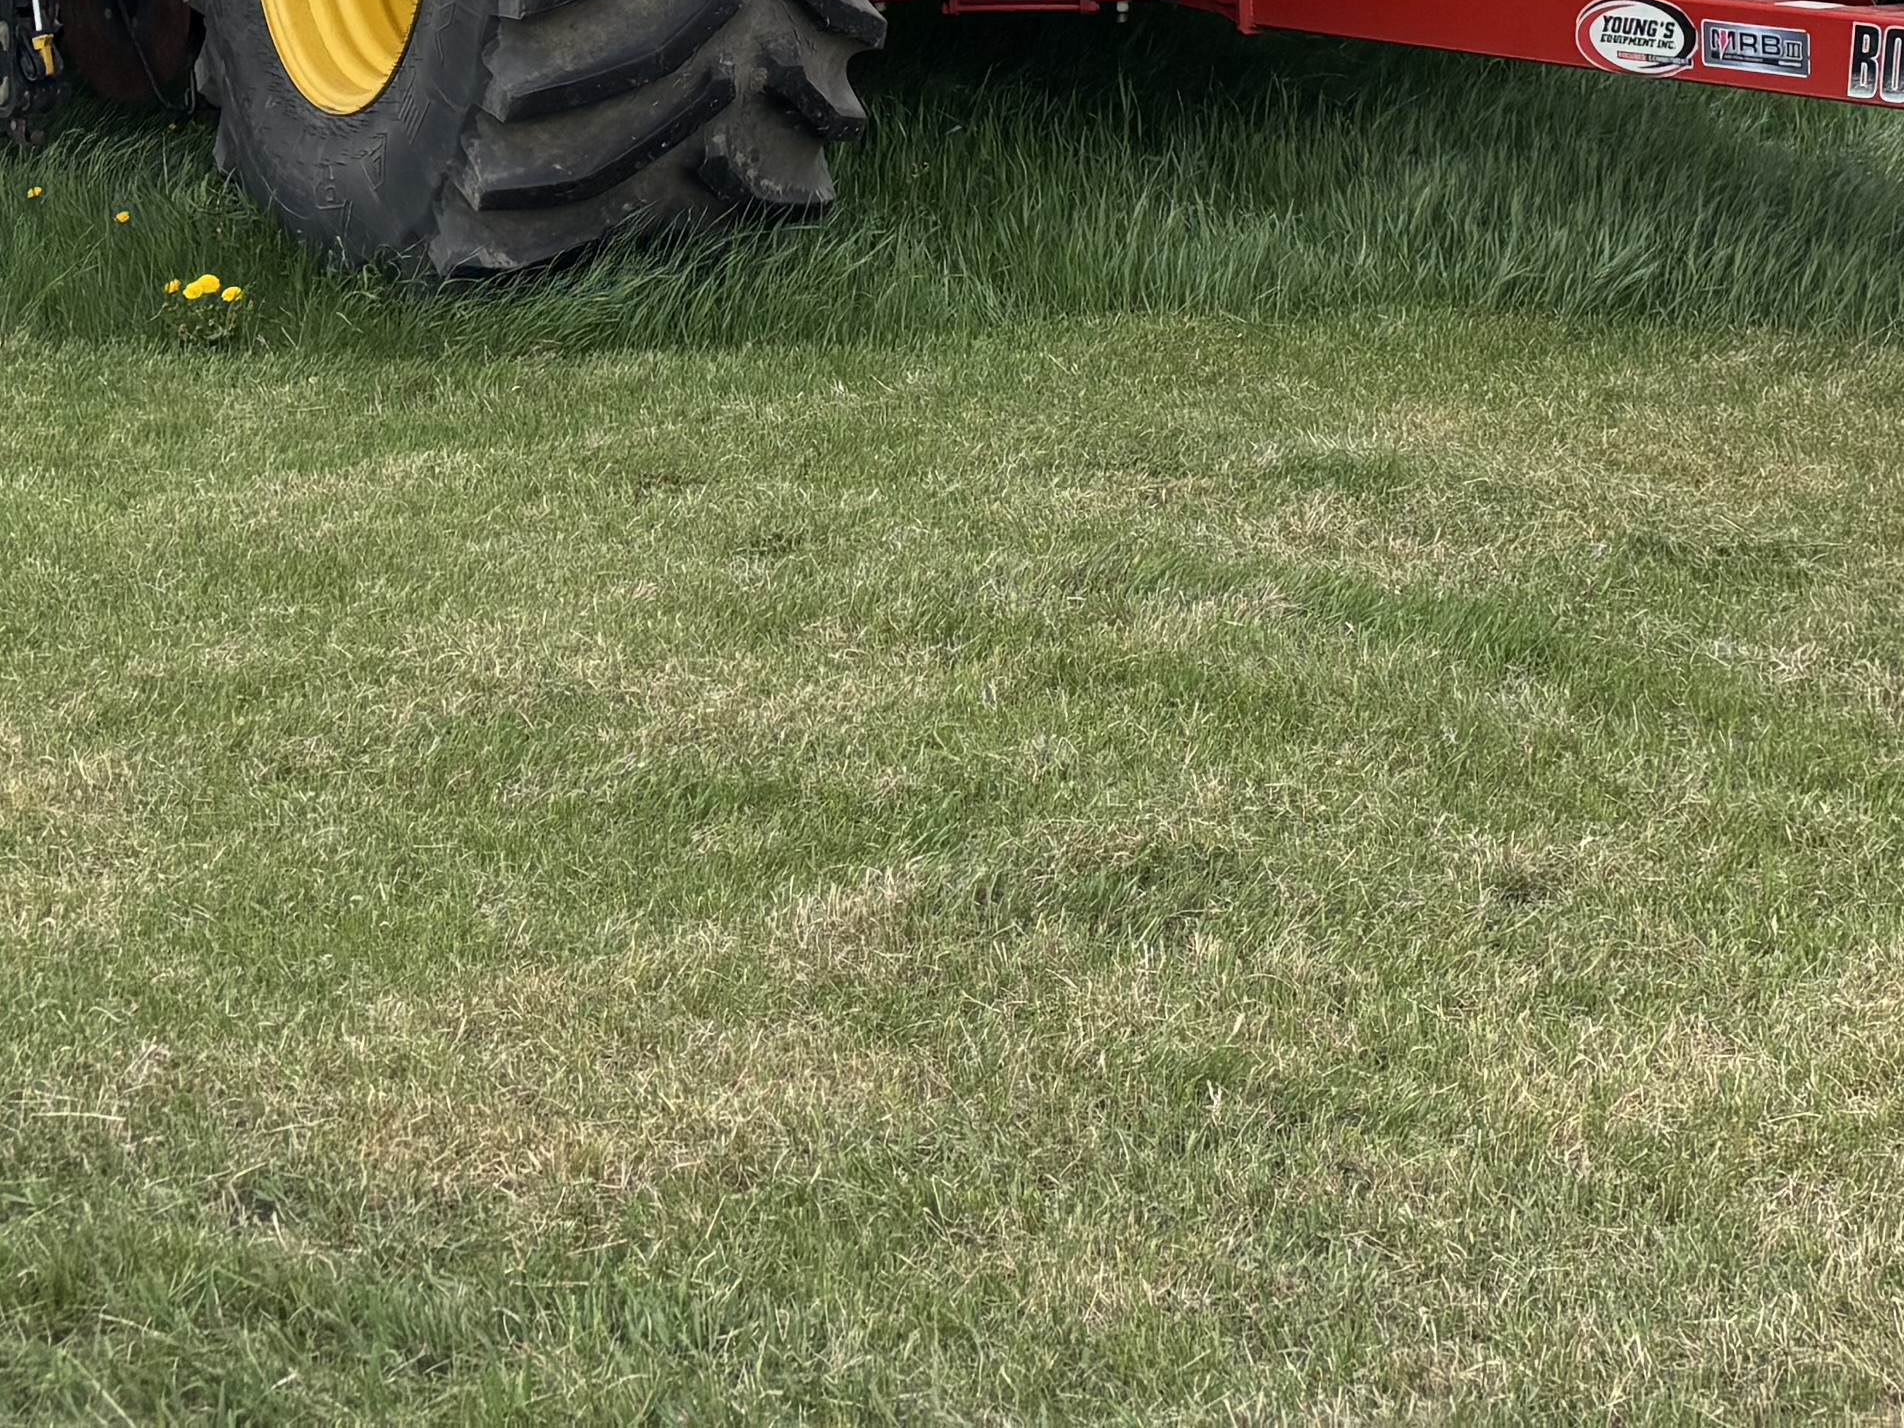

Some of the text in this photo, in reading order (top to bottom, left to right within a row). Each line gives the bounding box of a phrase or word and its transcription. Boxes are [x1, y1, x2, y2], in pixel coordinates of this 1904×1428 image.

[1602, 15, 1676, 39] YOUNG'S
[1600, 33, 1676, 50] EQUIPMENT INC.
[1710, 26, 1802, 60] MRB III
